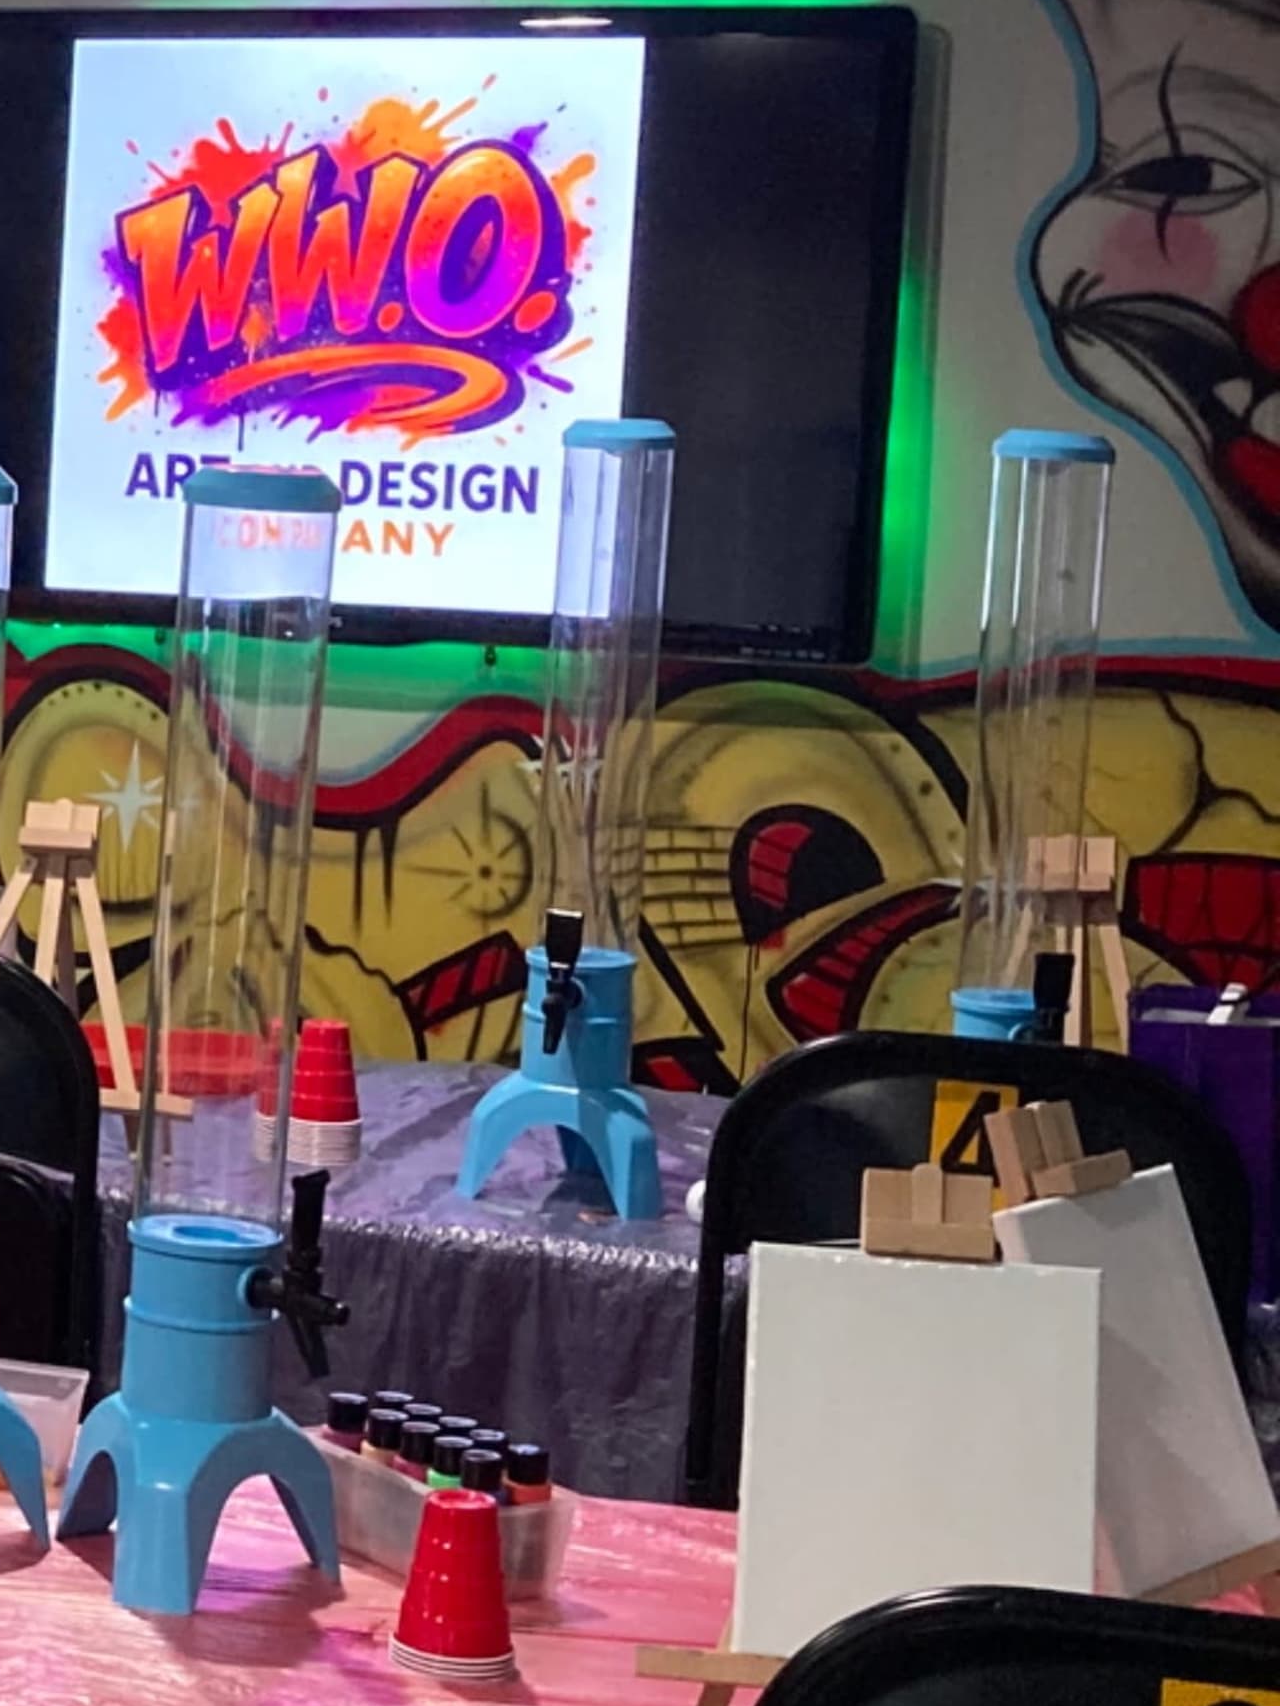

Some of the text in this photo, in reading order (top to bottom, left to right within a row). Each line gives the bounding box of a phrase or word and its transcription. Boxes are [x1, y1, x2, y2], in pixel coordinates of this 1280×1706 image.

[124, 451, 540, 514] AR DESIGN
[940, 1091, 1002, 1188] 4
